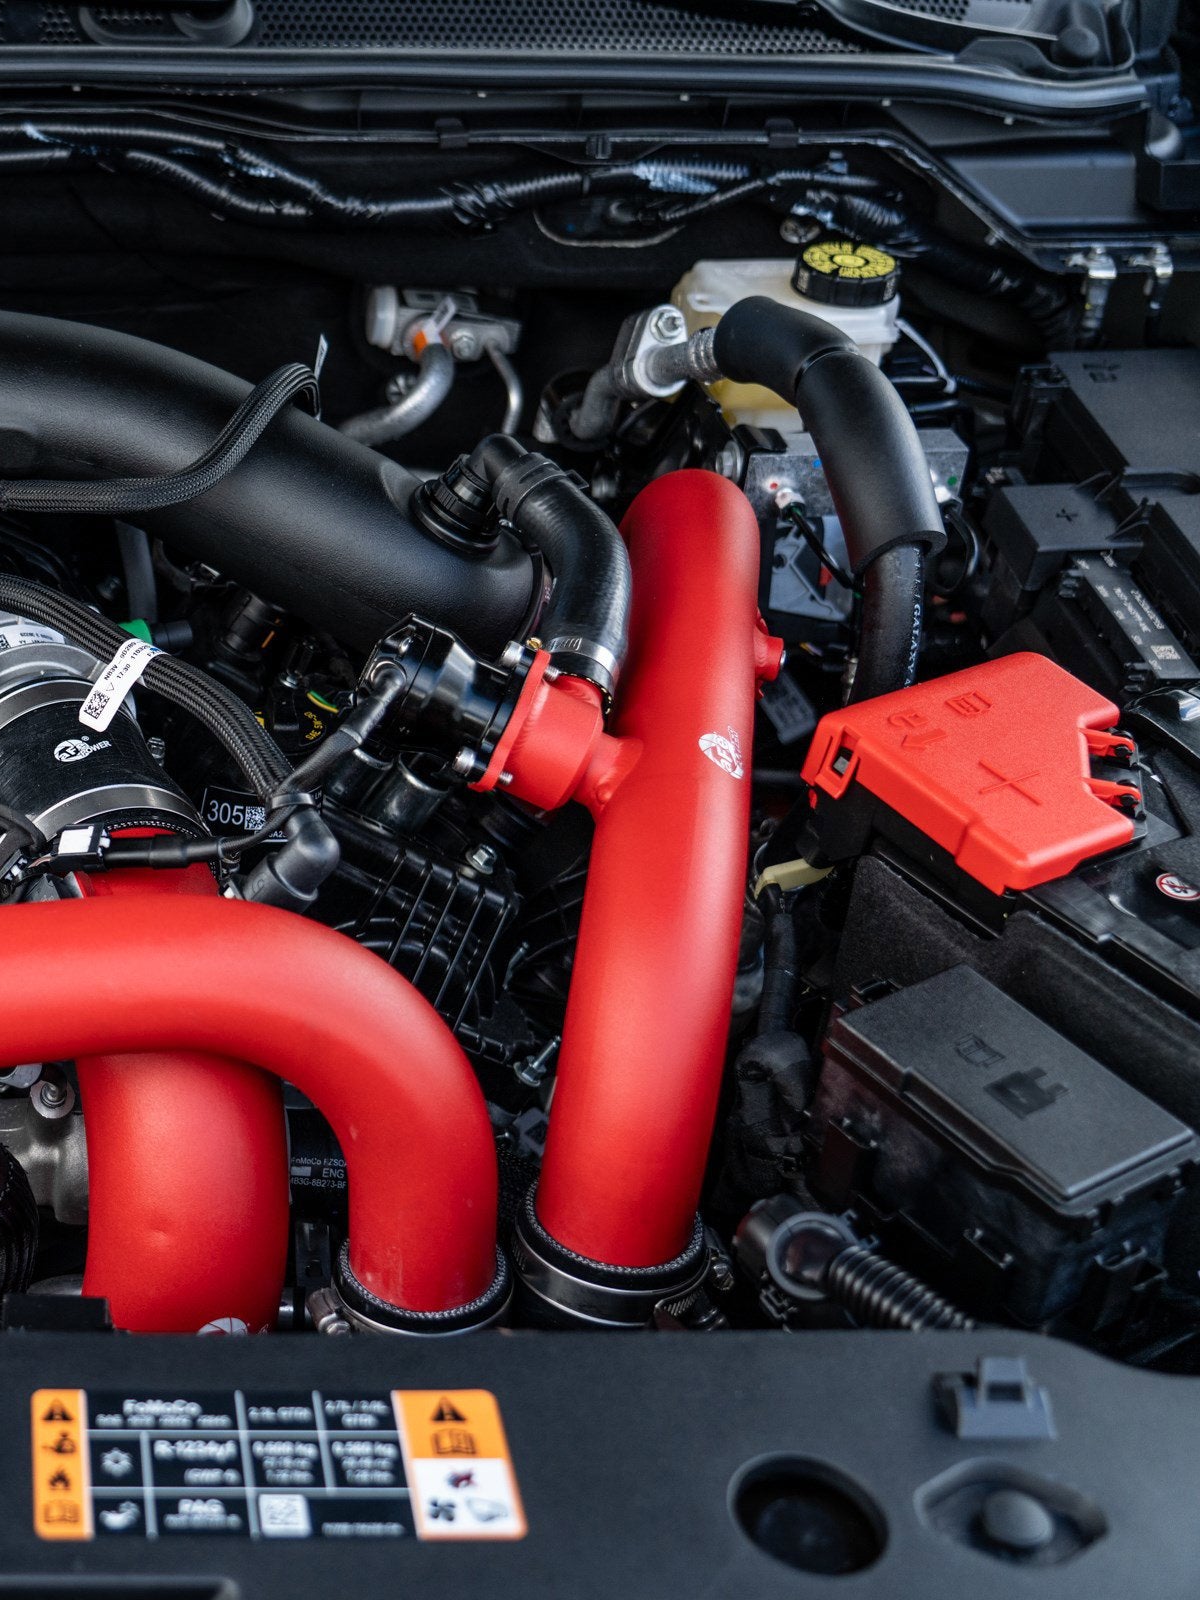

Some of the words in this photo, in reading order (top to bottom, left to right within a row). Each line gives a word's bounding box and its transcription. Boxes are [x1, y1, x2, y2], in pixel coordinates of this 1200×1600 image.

[78, 740, 112, 757] POWER
[207, 799, 245, 826] 305
[322, 1167, 345, 1179] ENG
